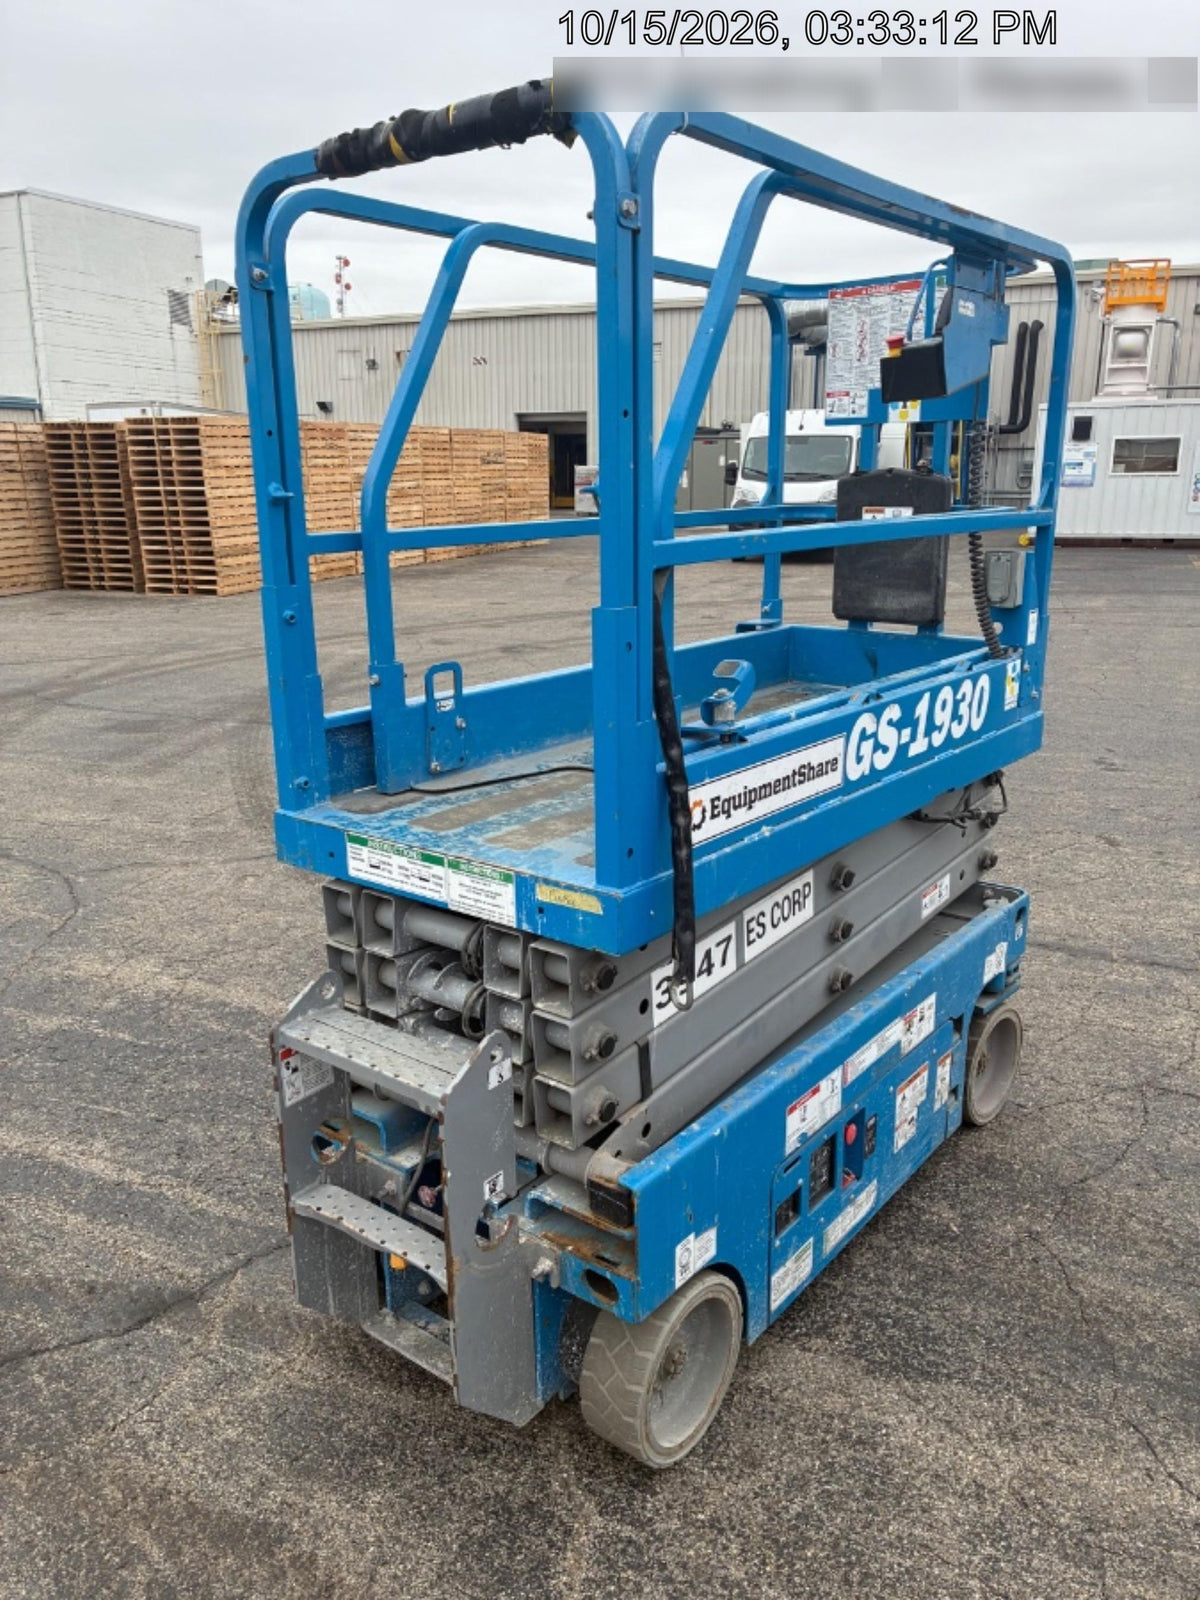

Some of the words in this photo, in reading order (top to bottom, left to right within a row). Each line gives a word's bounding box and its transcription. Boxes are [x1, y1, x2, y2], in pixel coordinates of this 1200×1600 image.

[845, 673, 990, 781] GS-1930
[709, 757, 838, 820] EquipmentShare
[746, 911, 766, 947] ES
[771, 881, 812, 930] CORP
